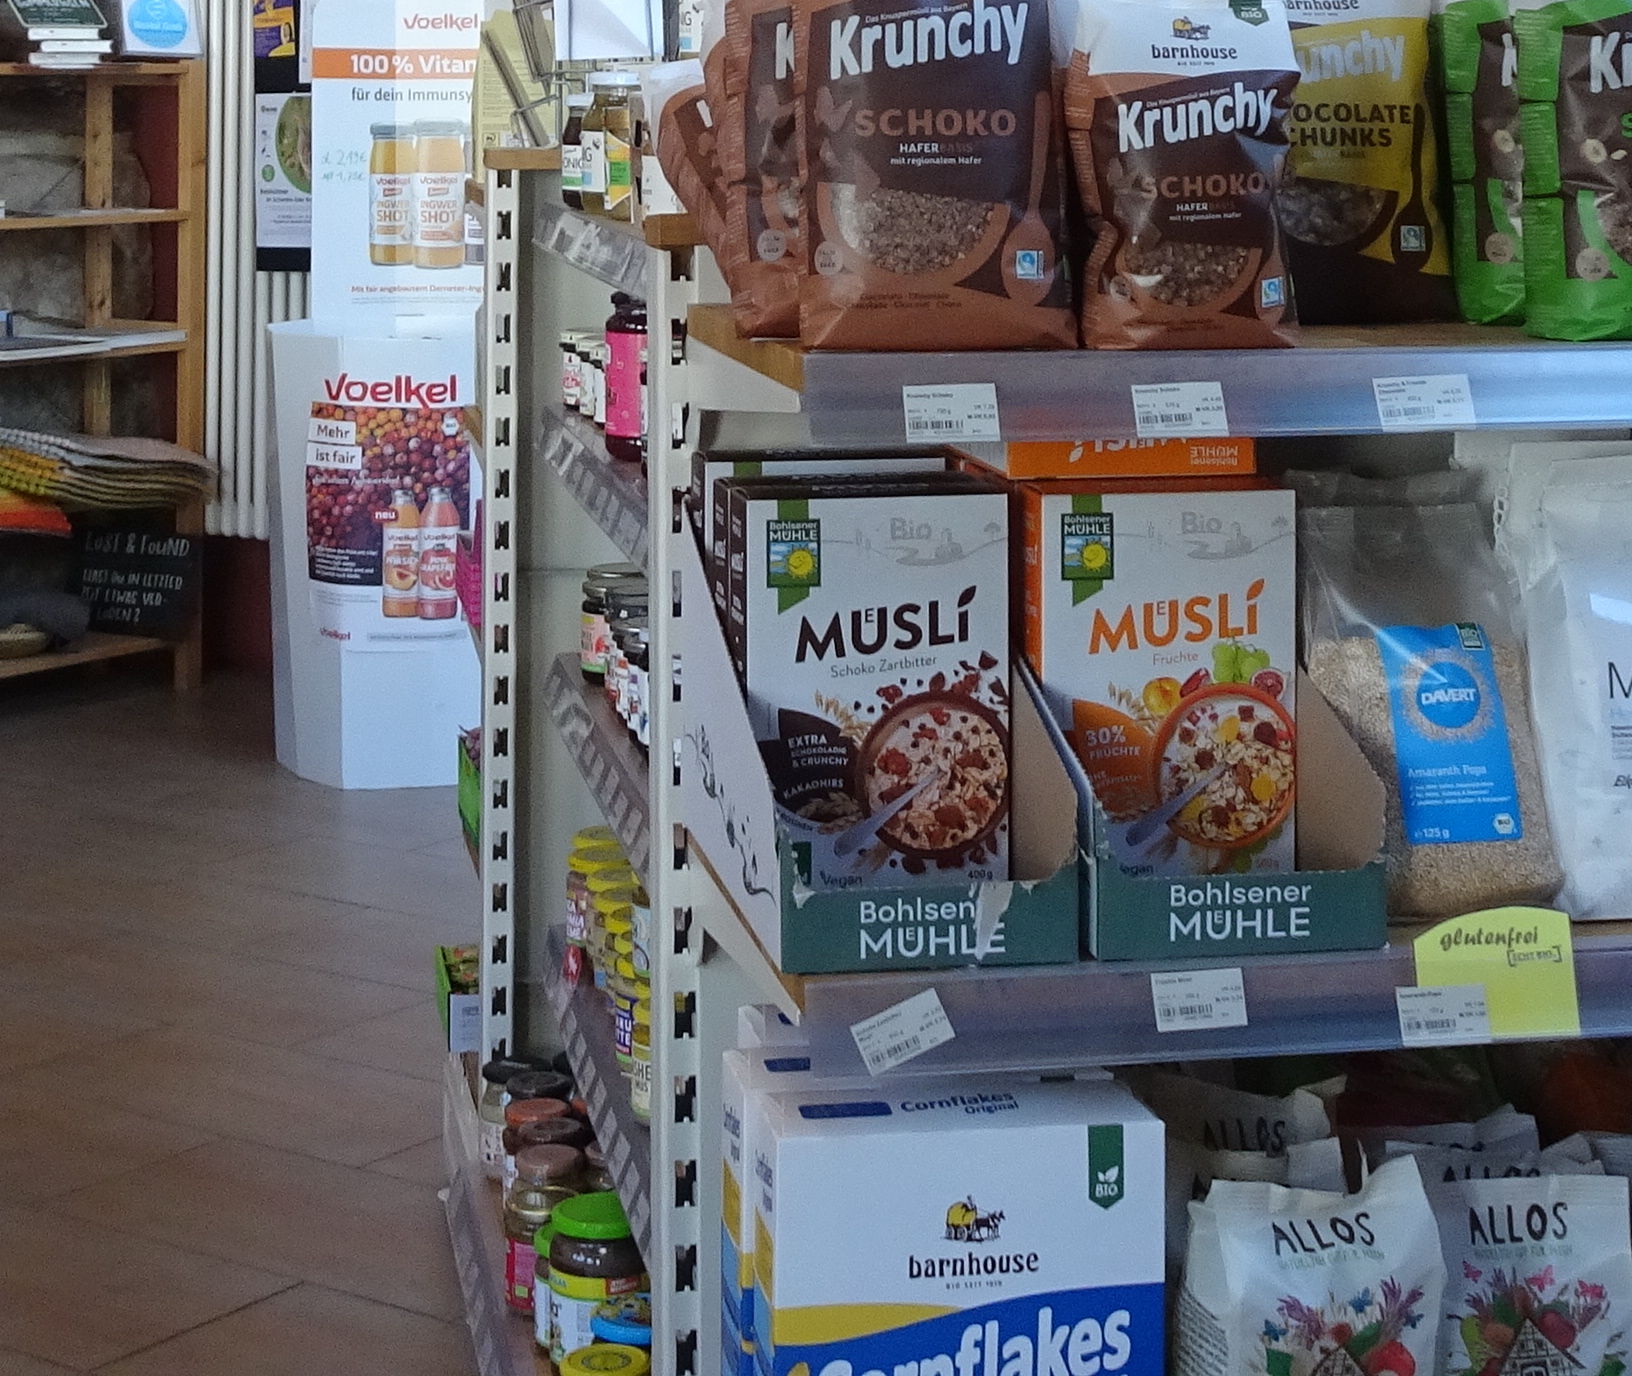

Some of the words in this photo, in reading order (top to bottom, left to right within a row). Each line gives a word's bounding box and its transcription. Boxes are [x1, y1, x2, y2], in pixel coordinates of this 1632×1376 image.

[402, 13, 479, 32] Voelkel
[350, 54, 392, 74] 100
[392, 54, 413, 73] %
[351, 86, 372, 102] für
[374, 86, 404, 102] dein
[407, 87, 473, 104] Immunsy
[855, 108, 1017, 137] SCHOKO
[1117, 81, 1278, 154] Krunchy
[1292, 103, 1412, 124] OCOLATE
[890, 155, 906, 165] mit
[958, 155, 982, 165] Hafer
[1141, 173, 1265, 201] SCHOKO
[421, 200, 458, 210] INGWER
[420, 211, 456, 224] SHOT
[324, 373, 459, 408] Voelkel
[316, 425, 351, 439] Mehr
[315, 449, 331, 463] ist
[333, 449, 356, 464] fair
[374, 510, 396, 521] neu
[140, 533, 190, 557] FOUND
[830, 661, 876, 679] Schoko
[878, 654, 938, 674] Zartbitter
[1420, 687, 1478, 707] DAVERT
[1170, 882, 1312, 908] Bohlsener
[1169, 906, 1311, 943] MÜHLE
[1440, 924, 1539, 952] glutenfrei
[900, 1091, 1014, 1113] Cornflakes
[964, 1100, 1019, 1117] Original
[1094, 1182, 1119, 1197] BIO
[1272, 1210, 1376, 1256] ALLOS
[908, 1251, 1040, 1280] barnhouse
